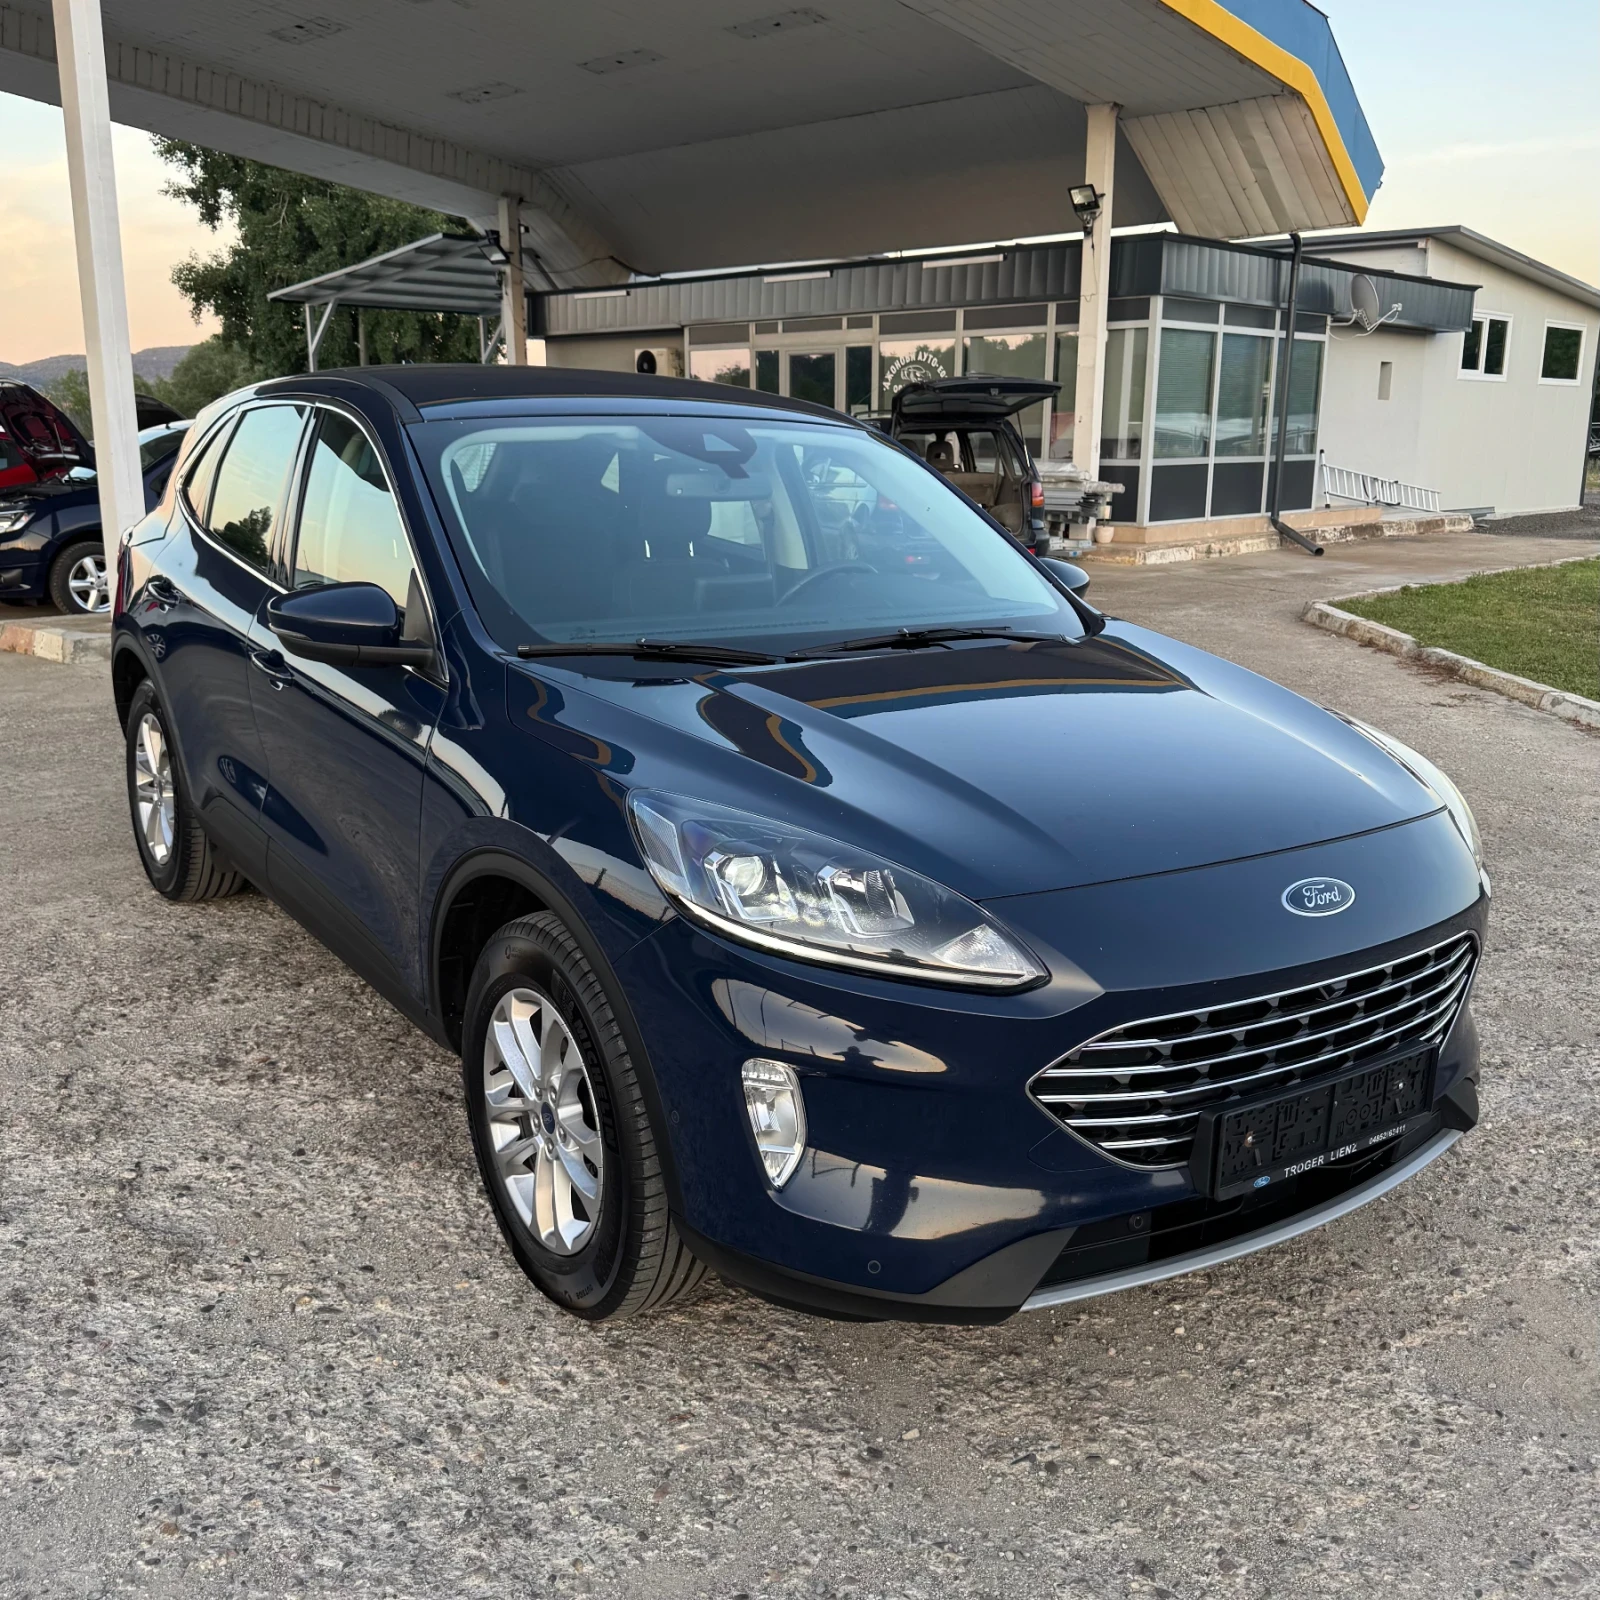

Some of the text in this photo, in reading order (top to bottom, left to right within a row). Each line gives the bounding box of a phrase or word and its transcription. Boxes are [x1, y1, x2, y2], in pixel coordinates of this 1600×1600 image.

[1302, 884, 1342, 908] Ford
[575, 1020, 617, 1149] MICHELIN
[1284, 1154, 1325, 1178] TROGER
[1330, 1143, 1358, 1161] LIENZ
